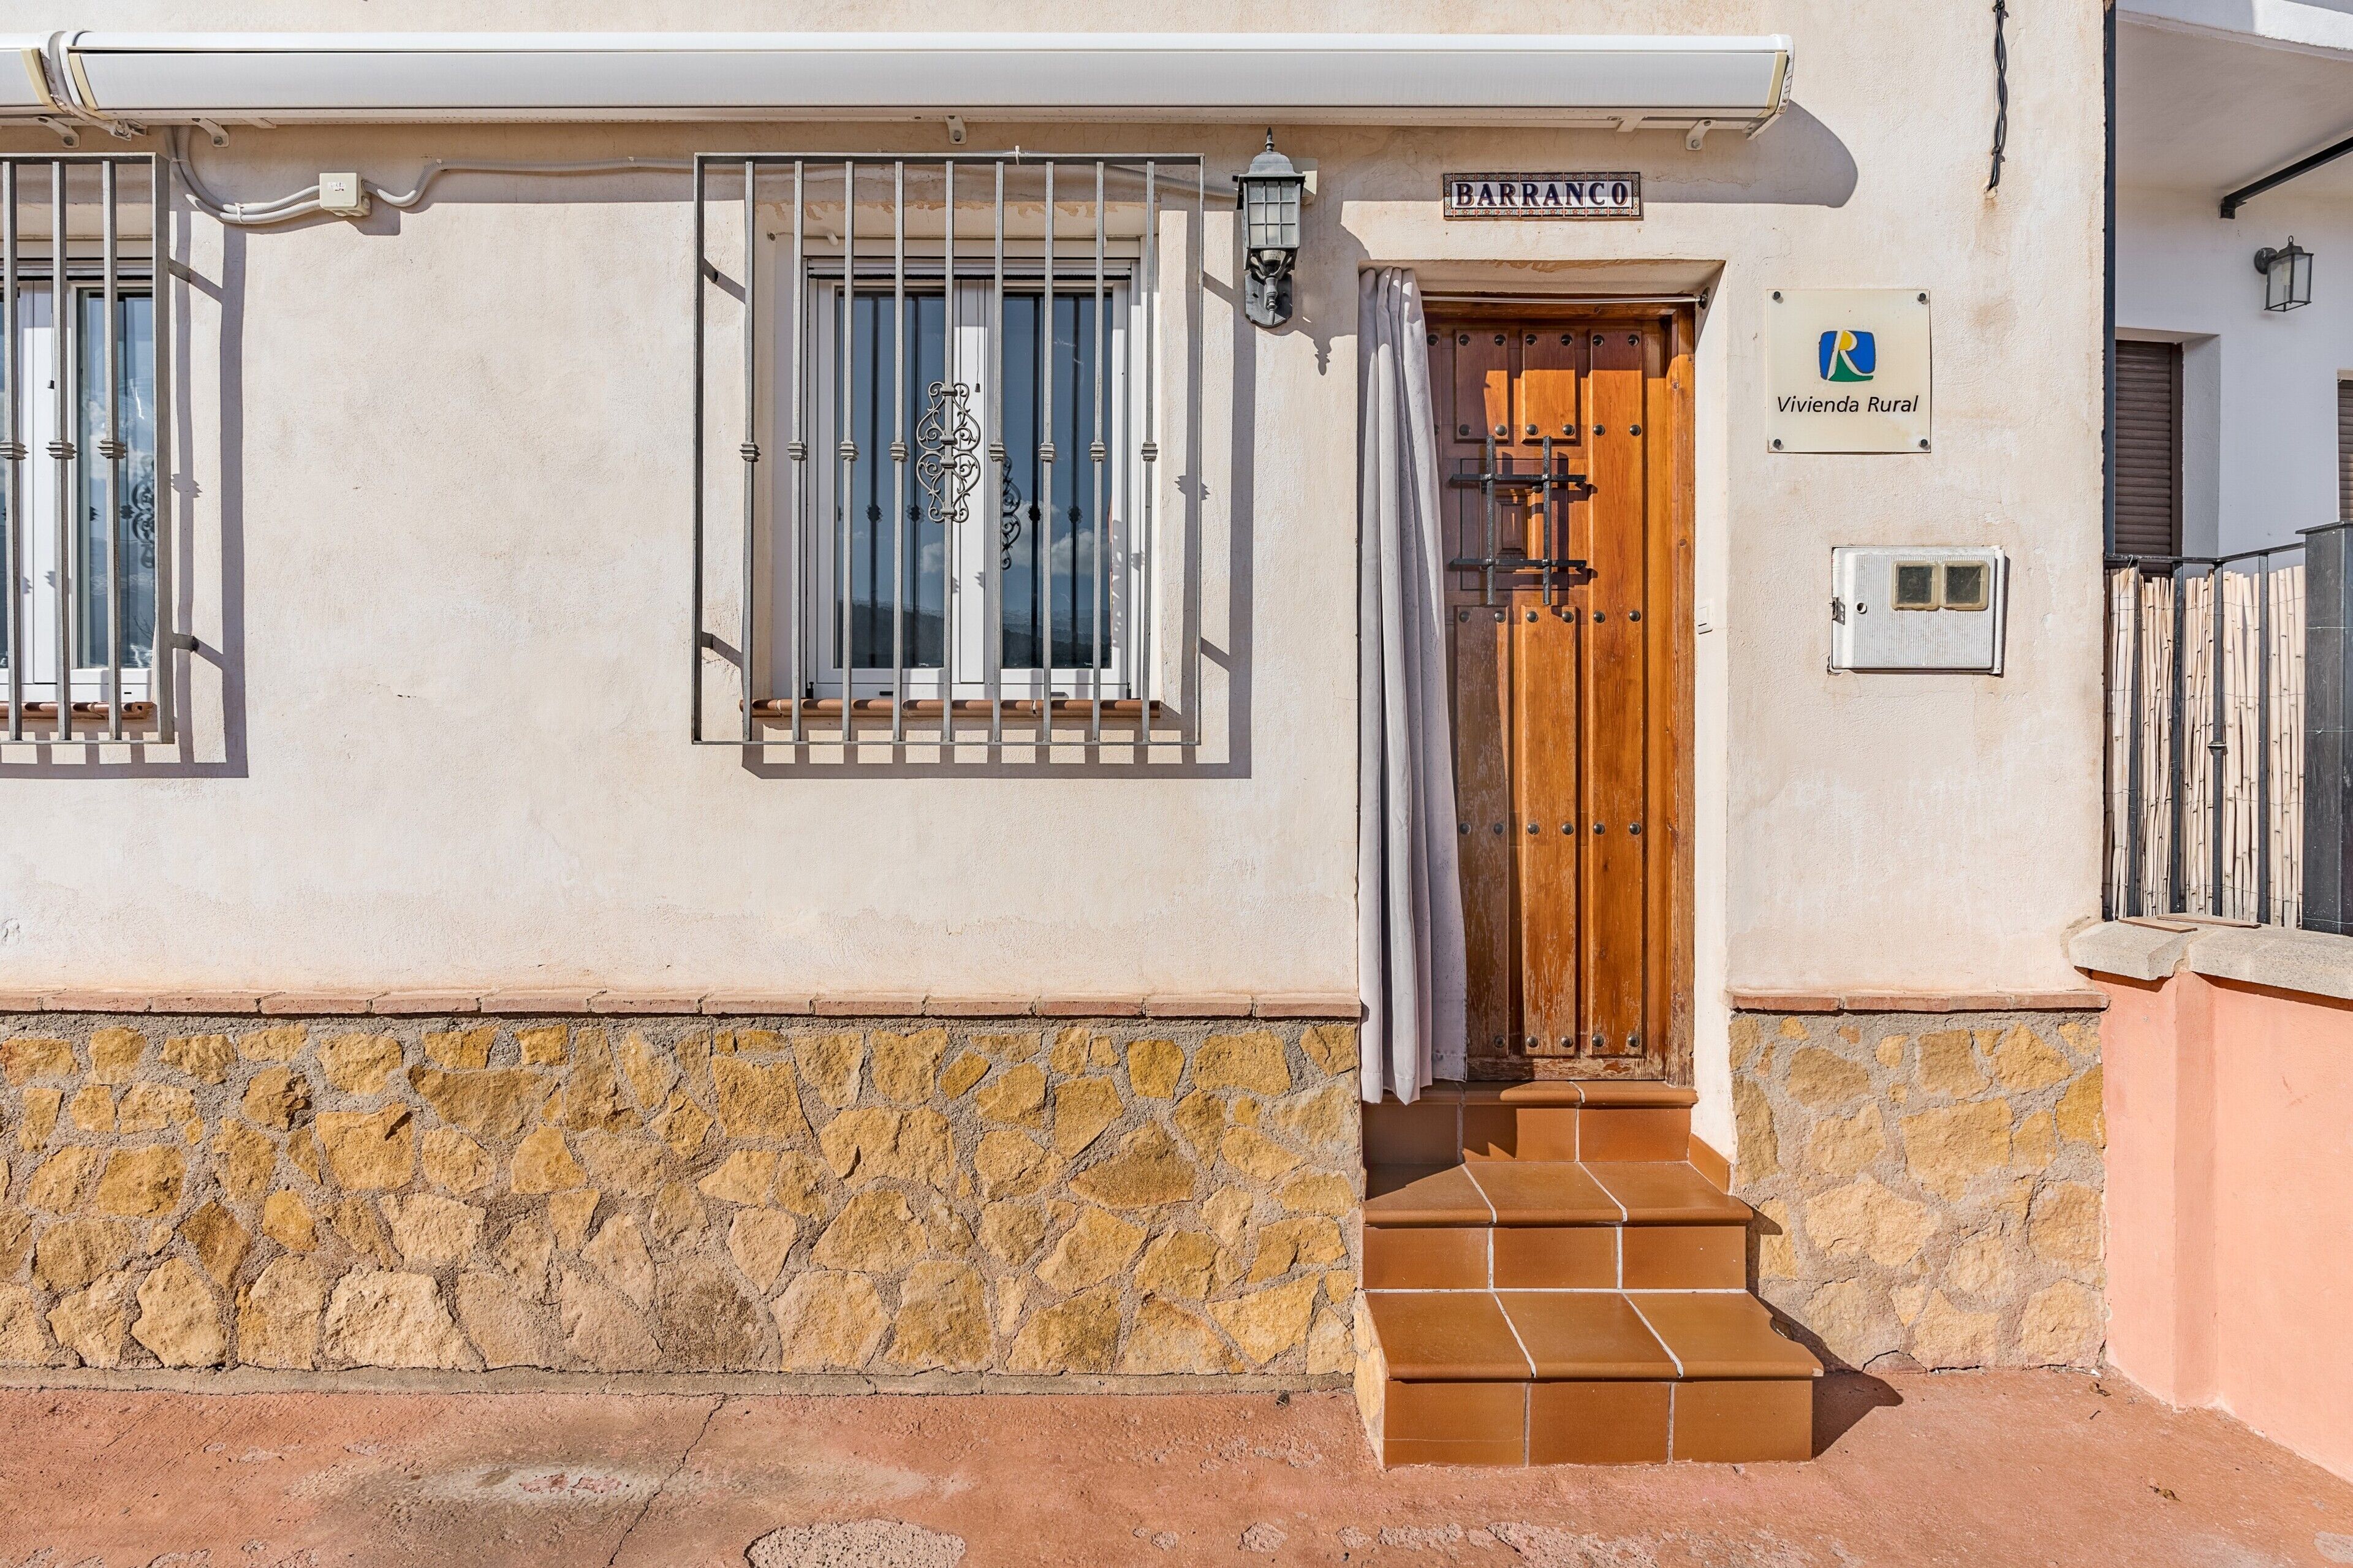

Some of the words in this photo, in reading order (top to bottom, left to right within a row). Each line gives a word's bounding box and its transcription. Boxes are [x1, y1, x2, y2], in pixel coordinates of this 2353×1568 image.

[1455, 183, 1629, 206] BARRANCO
[1777, 396, 1859, 412] Vivienda
[1867, 395, 1919, 412] Rural
